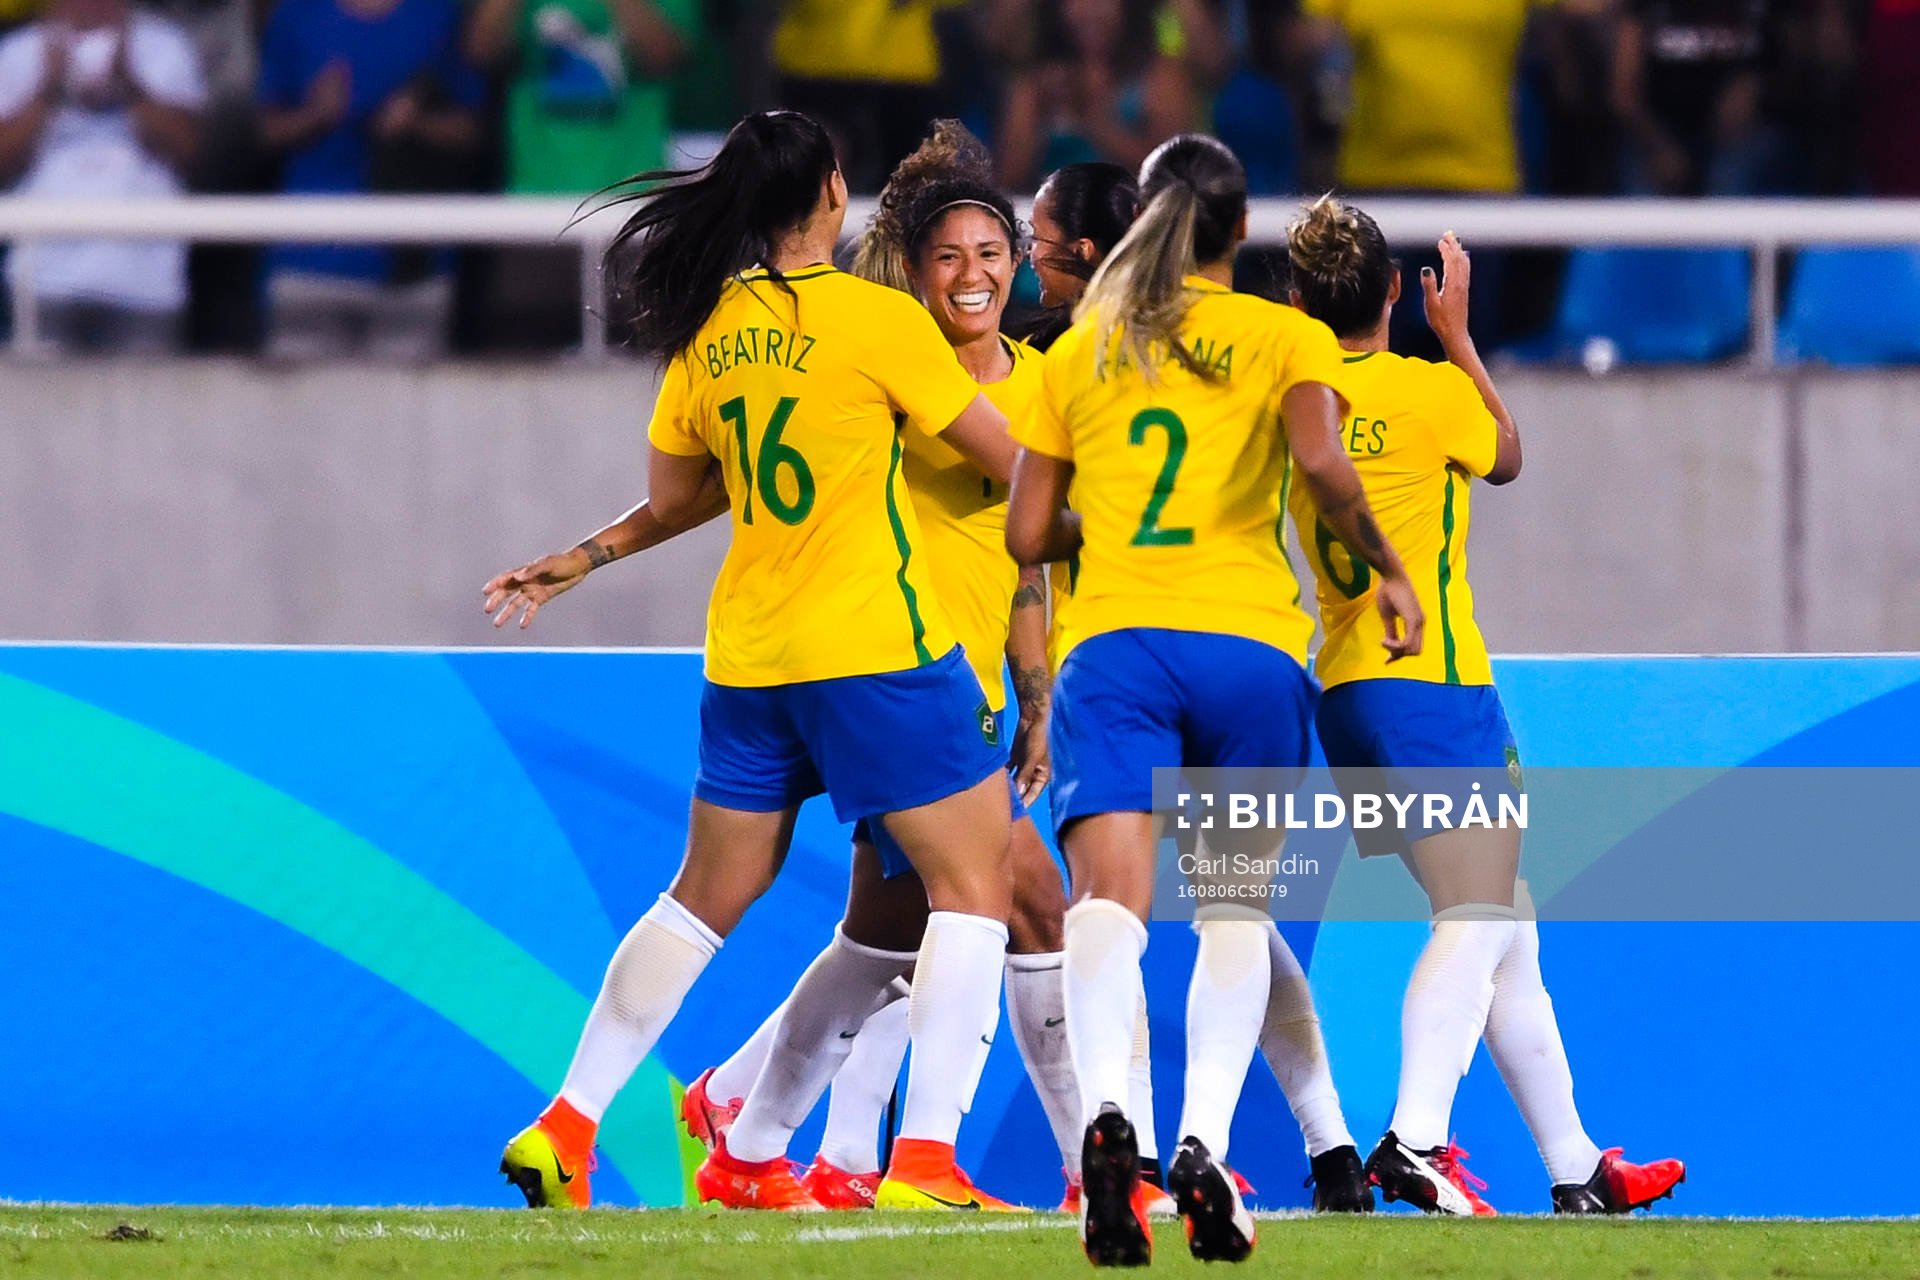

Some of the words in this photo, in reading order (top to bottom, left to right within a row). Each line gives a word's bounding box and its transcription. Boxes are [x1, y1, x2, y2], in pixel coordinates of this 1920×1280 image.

[707, 326, 817, 380] BEATRIZ
[718, 395, 816, 526] 16
[1127, 406, 1195, 547] 2
[1338, 416, 1387, 455] ES
